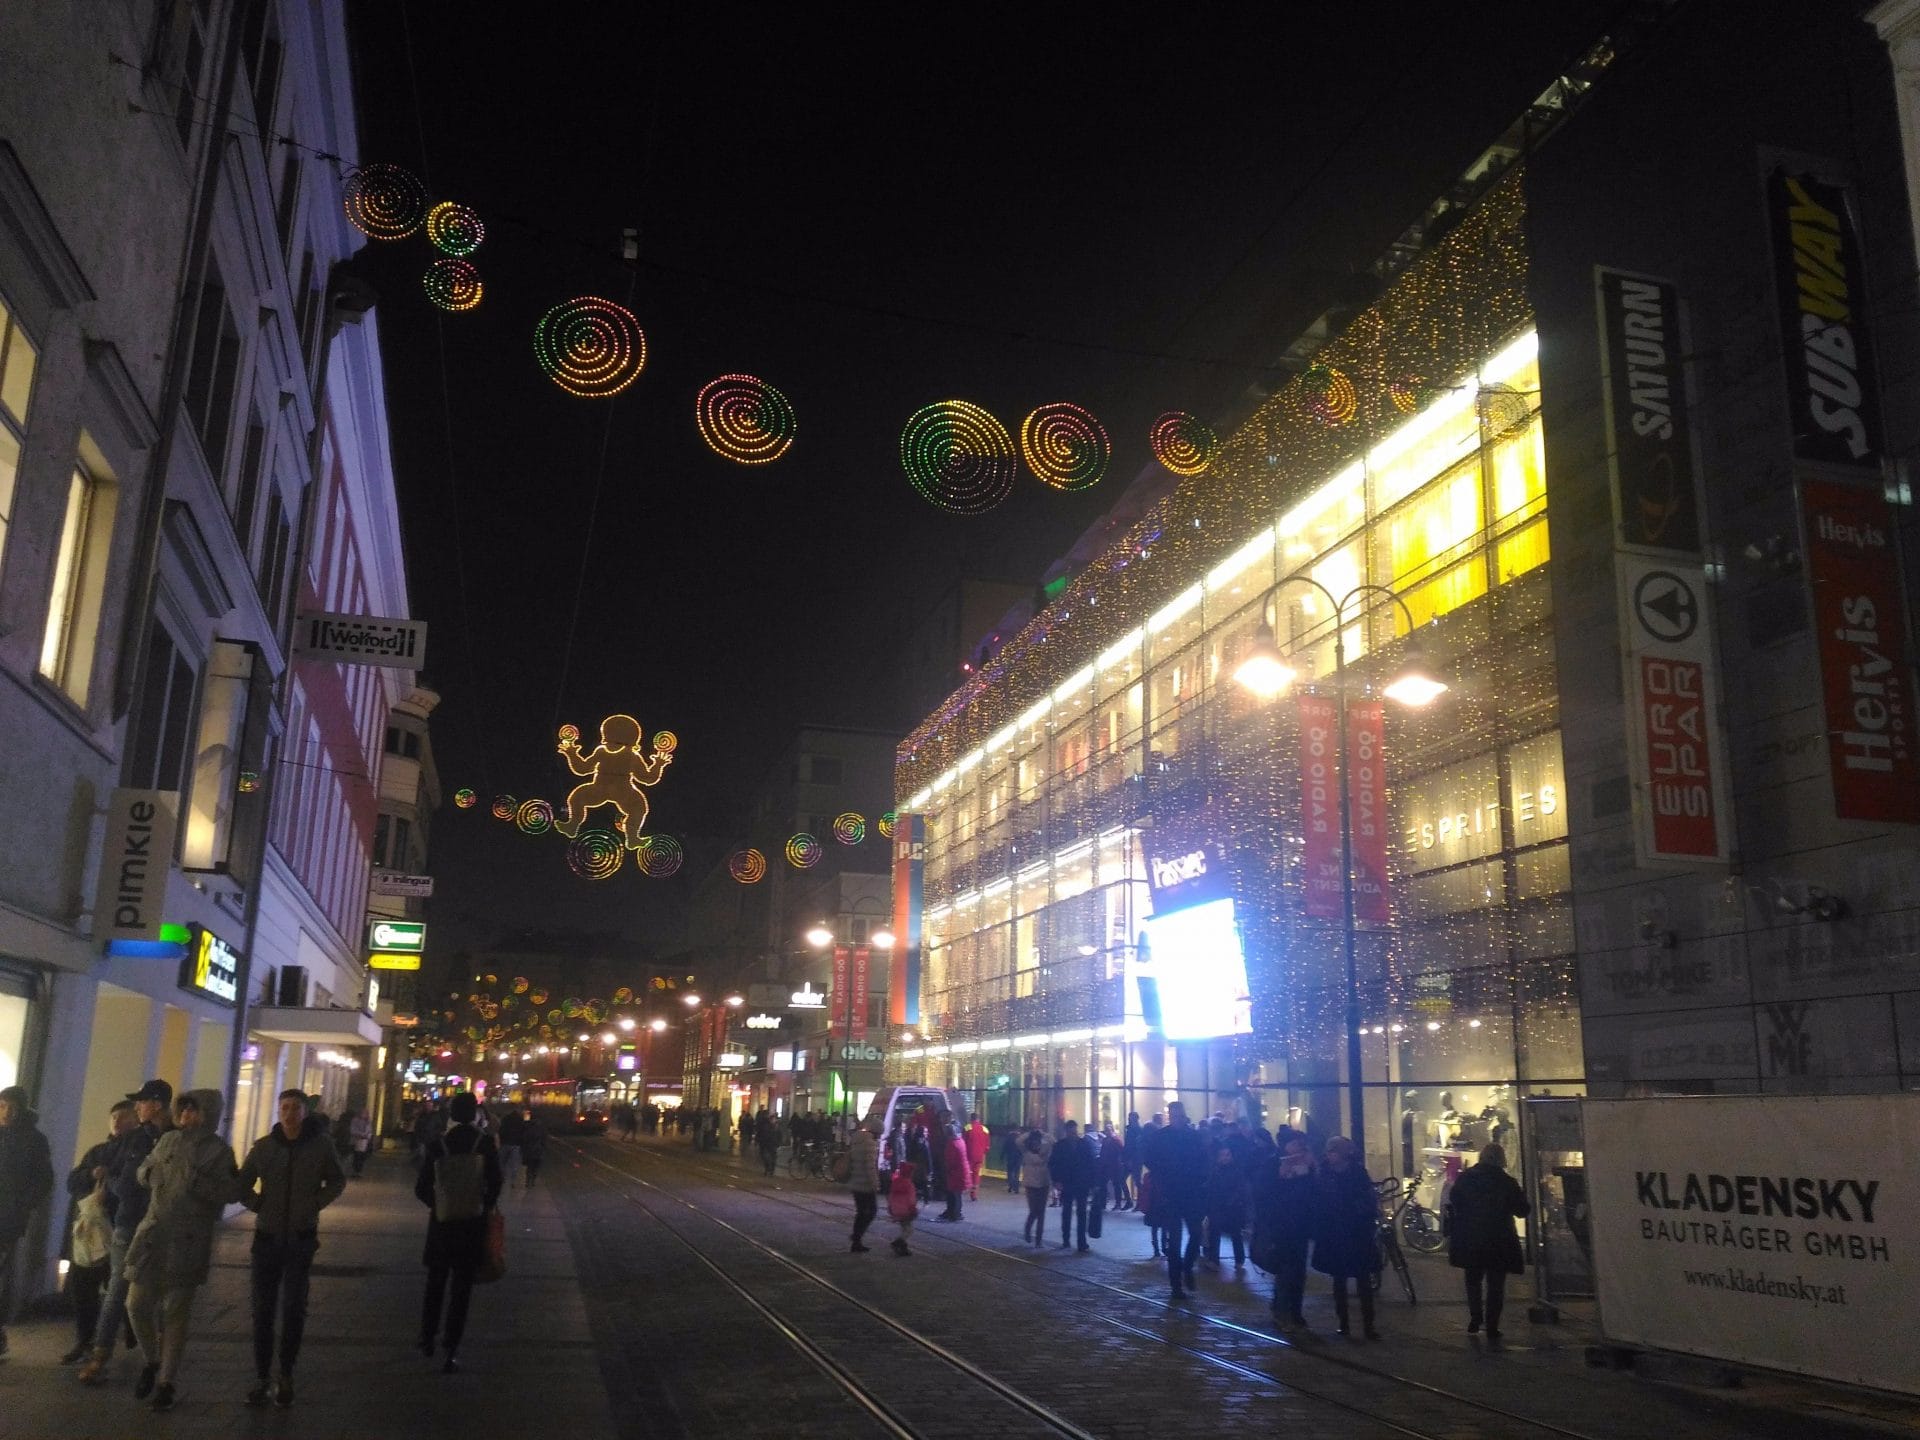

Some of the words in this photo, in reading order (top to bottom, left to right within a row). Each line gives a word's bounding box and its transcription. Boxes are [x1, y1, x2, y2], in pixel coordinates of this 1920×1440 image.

[1785, 177, 1871, 459] SUBWAY
[1621, 280, 1673, 440] SATURN
[1818, 515, 1885, 548] Hervis
[330, 627, 398, 649] Wolford
[1836, 596, 1893, 772] Hervis
[1647, 662, 1681, 817] EURO
[1673, 665, 1709, 818] SPAR
[1406, 802, 1499, 853] ESPRIT
[1636, 1171, 1880, 1223] KLADENSKY
[1640, 1218, 1792, 1253] BAUTRÄGER
[1804, 1231, 1890, 1262] GMBH
[1683, 1268, 1846, 1308] www.kladensky.at
